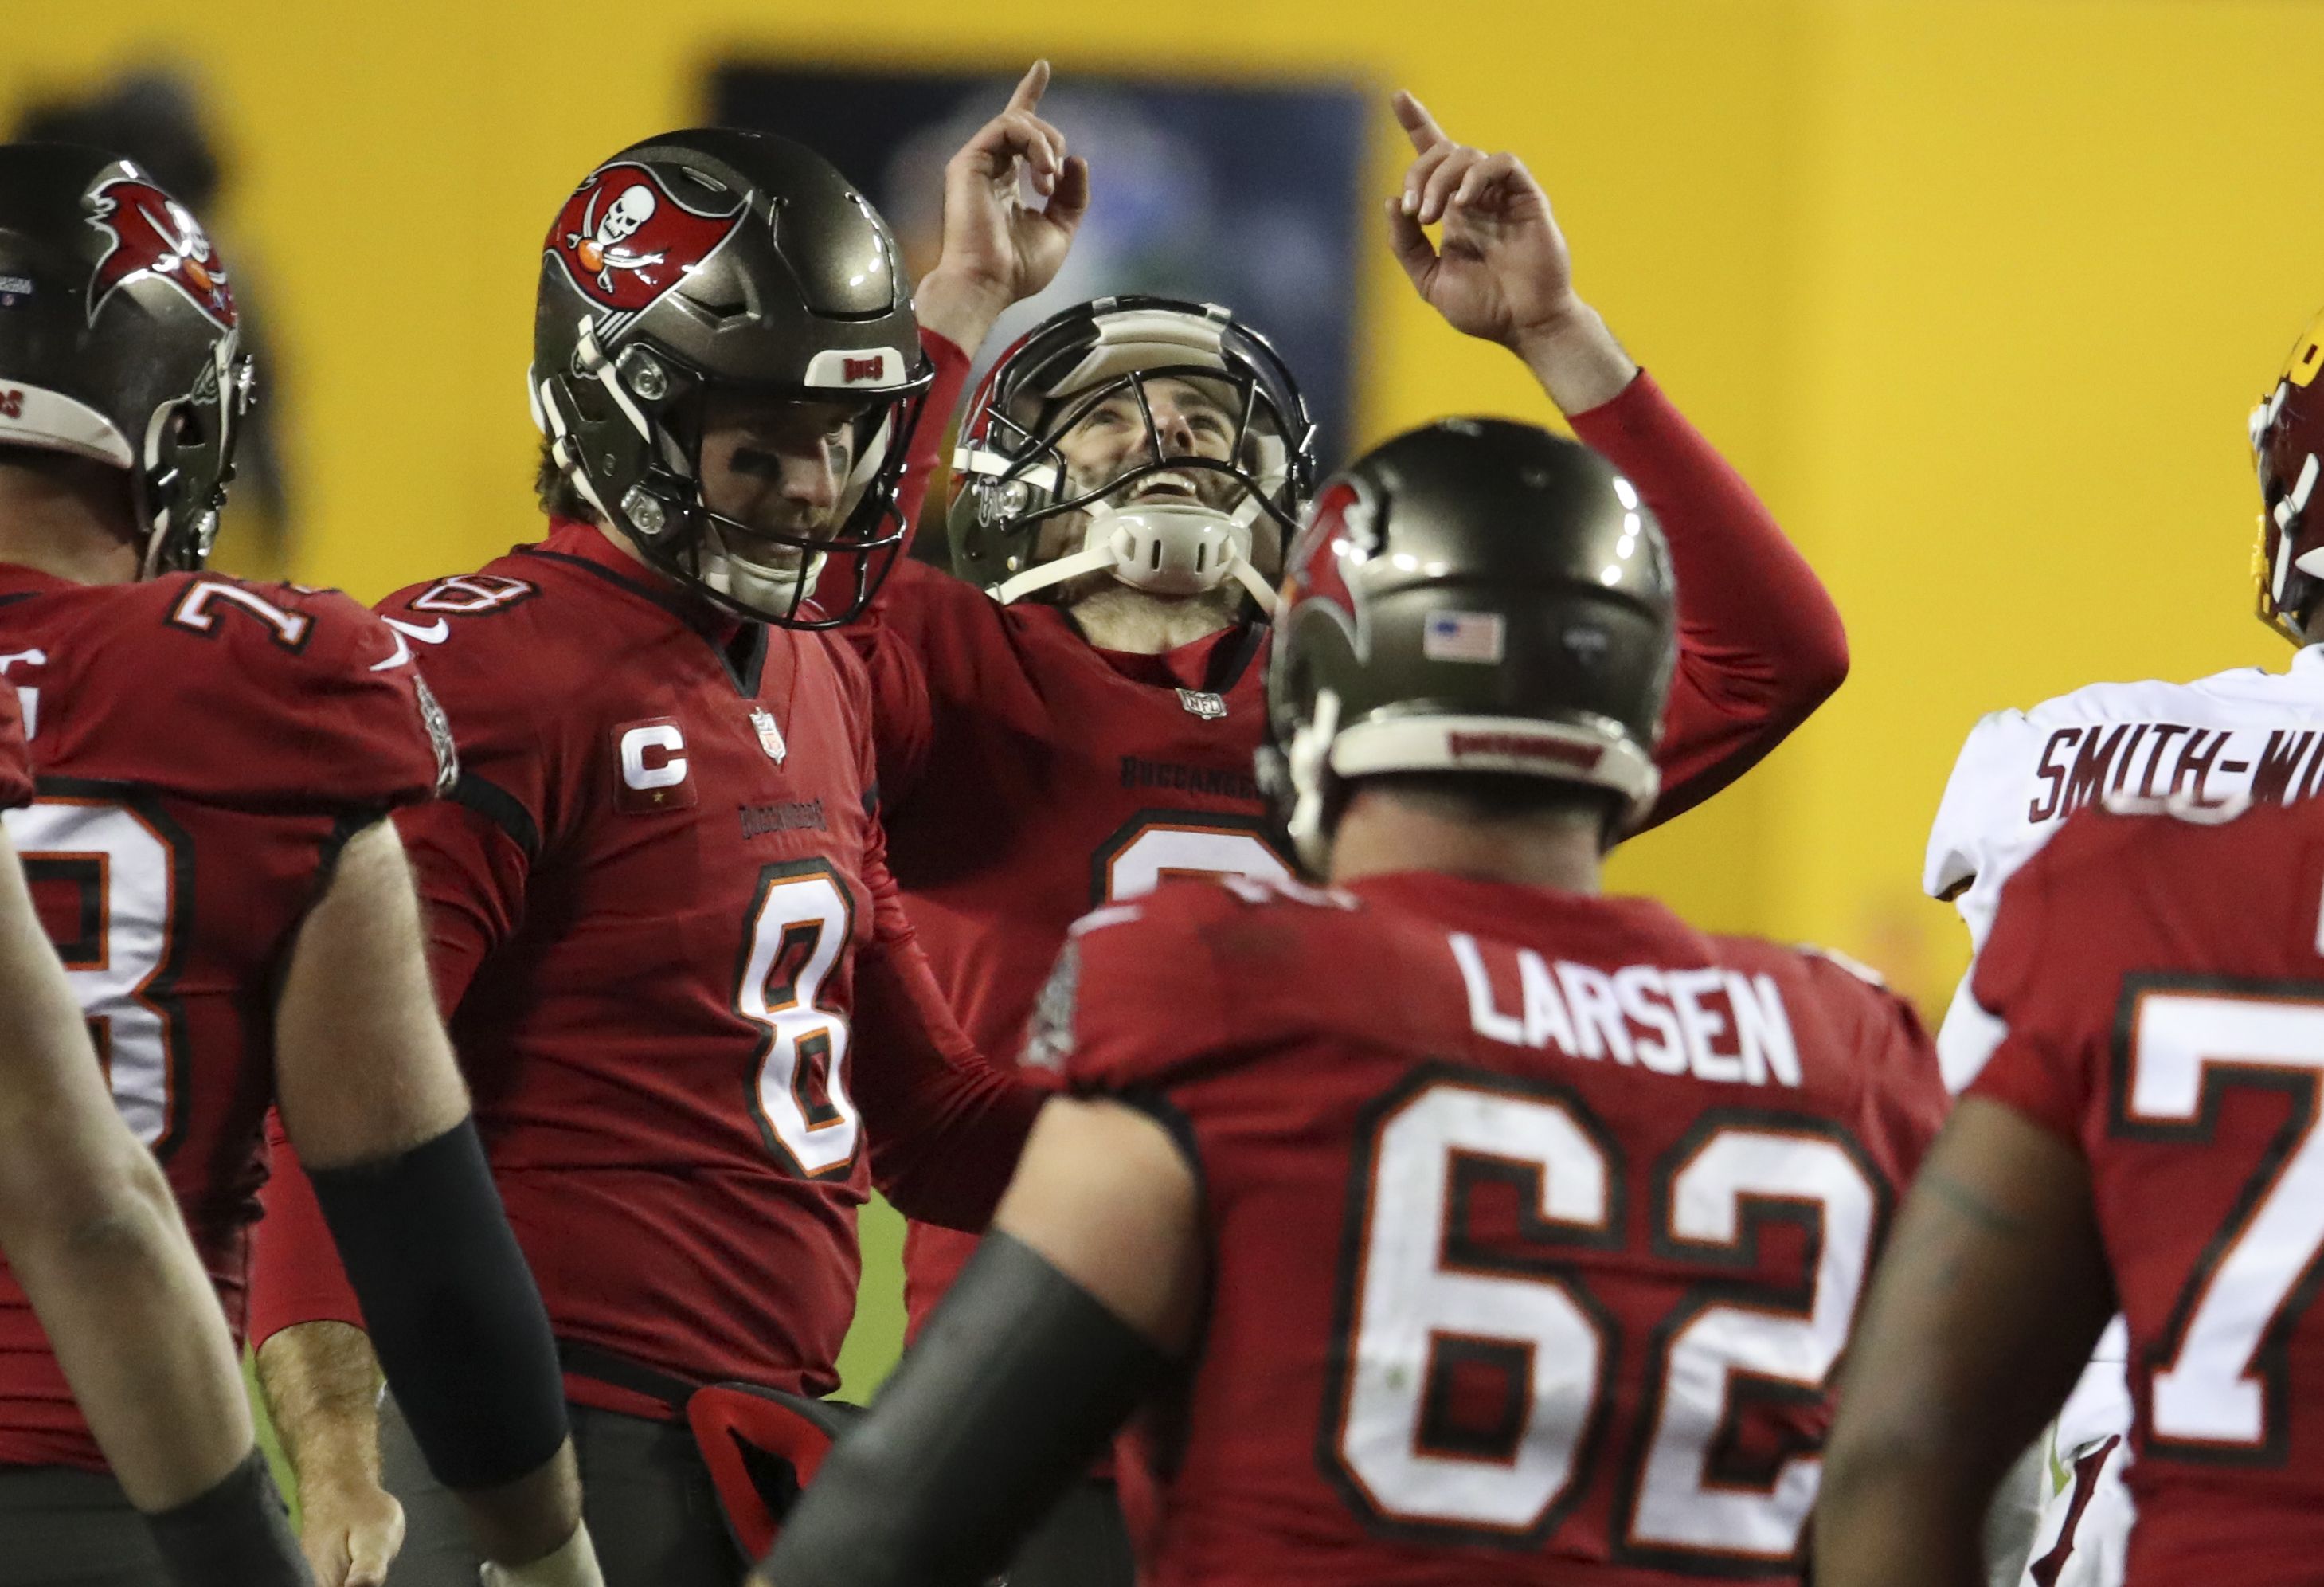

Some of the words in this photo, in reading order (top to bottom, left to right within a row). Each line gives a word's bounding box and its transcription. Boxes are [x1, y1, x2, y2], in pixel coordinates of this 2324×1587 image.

[621, 725, 687, 790] C
[738, 872, 859, 1179] 8
[1448, 931, 1804, 1088] LARSEN
[1338, 1079, 1880, 1560] 62
